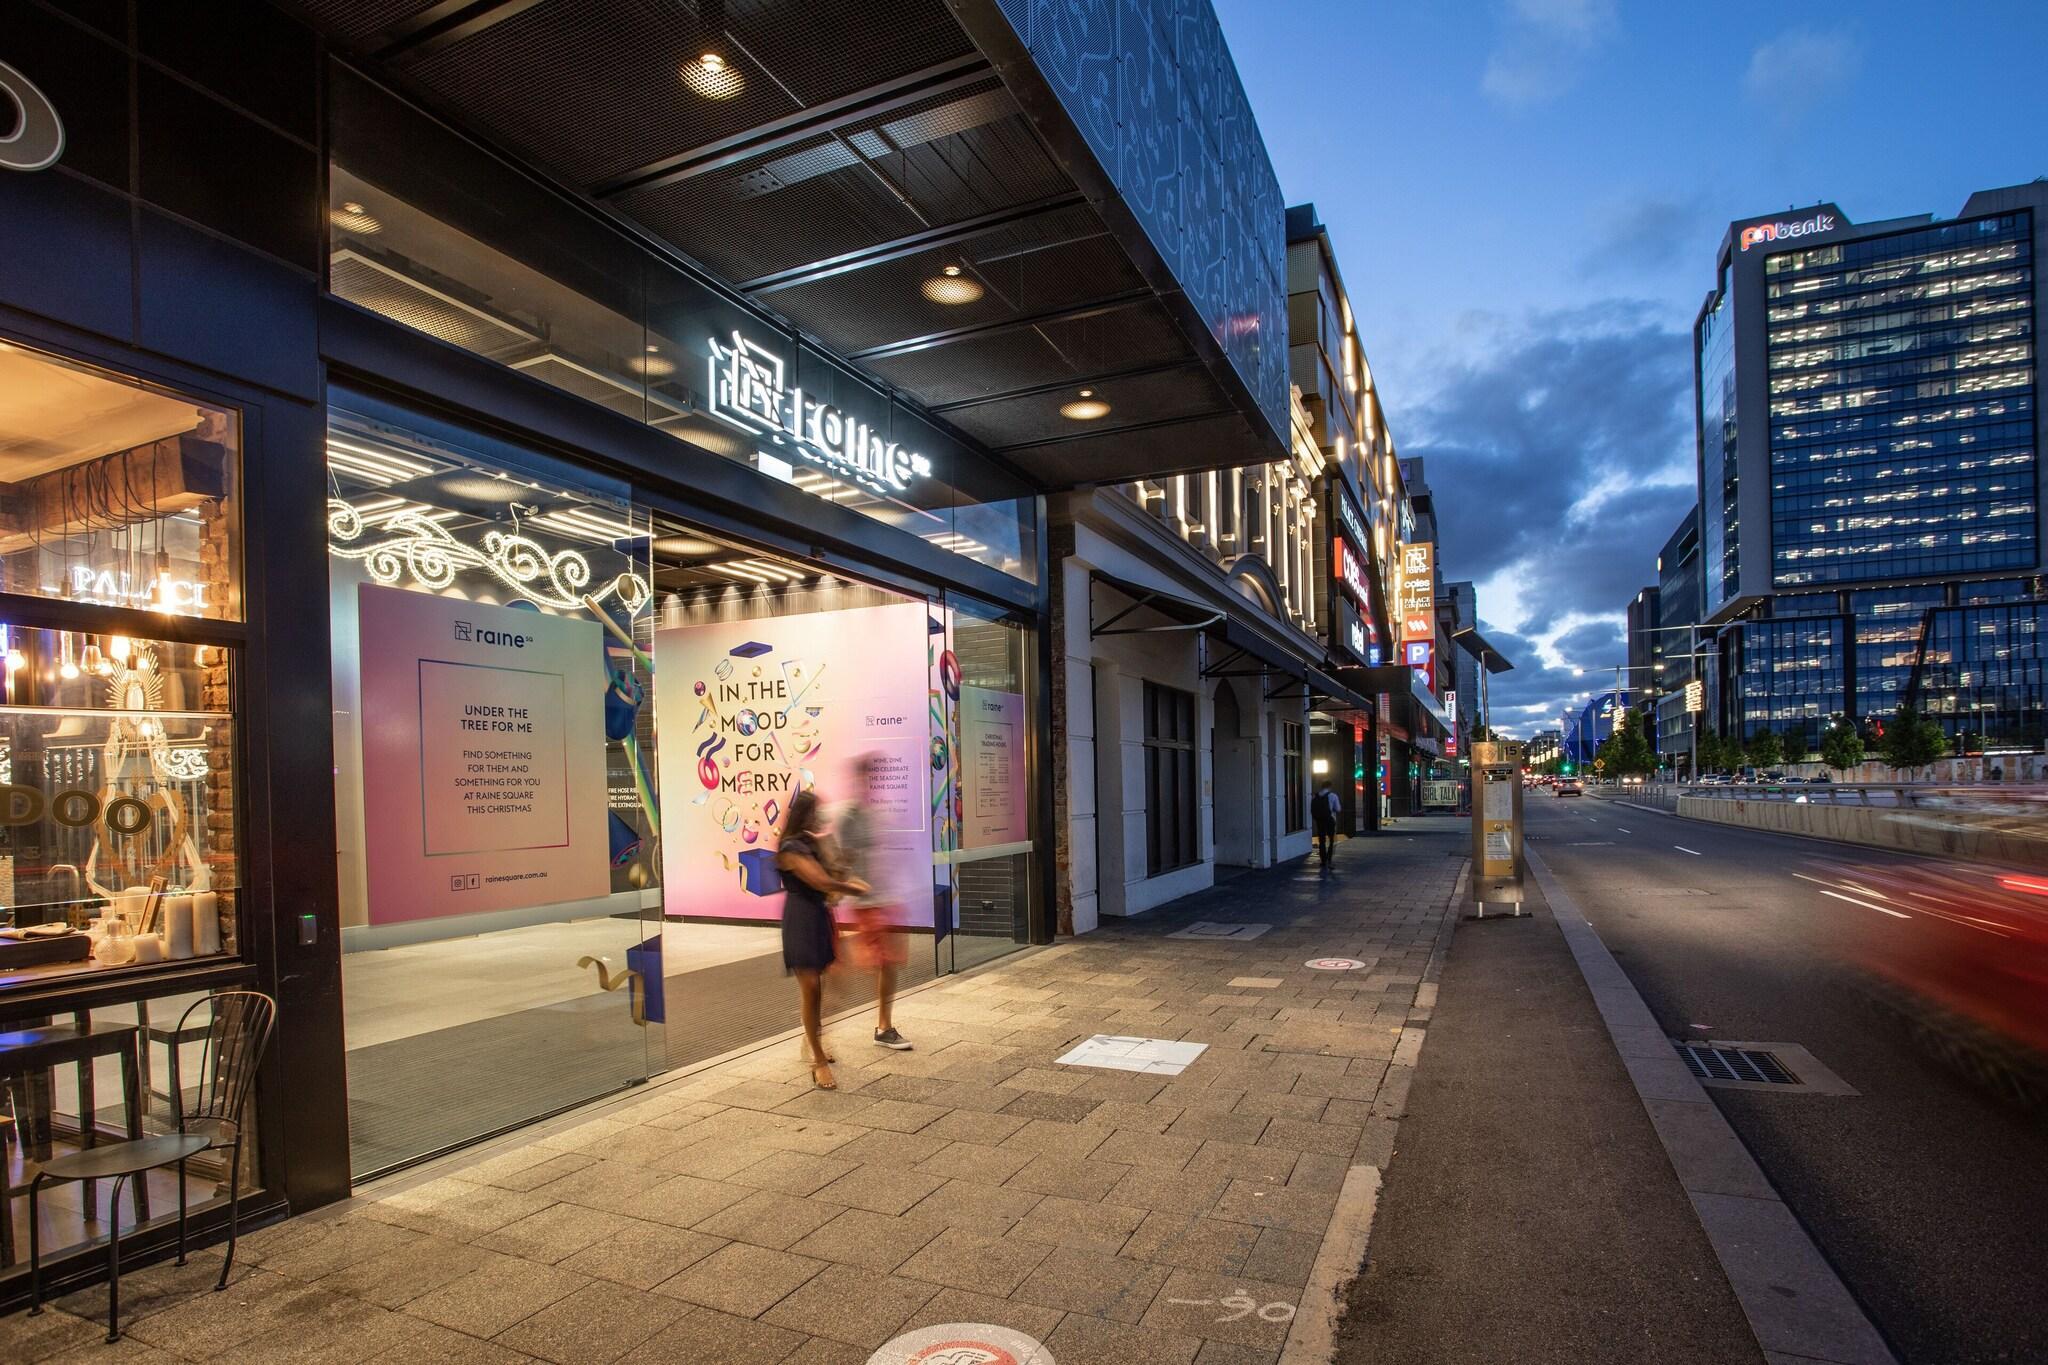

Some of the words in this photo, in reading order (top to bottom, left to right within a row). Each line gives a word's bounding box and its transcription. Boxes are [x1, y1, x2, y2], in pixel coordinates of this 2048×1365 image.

[476, 629, 525, 648] raine
[1412, 646, 1424, 661] P
[720, 683, 740, 702] IN
[748, 680, 787, 700] THE
[465, 704, 504, 717] UNDER
[508, 708, 528, 719] THE
[460, 719, 488, 731] TREE
[492, 721, 514, 732] FOR
[517, 723, 533, 733] ME
[721, 708, 788, 736] MOOD
[876, 716, 903, 726] raine
[463, 750, 483, 759] FIND
[484, 751, 532, 760] SOMETHING
[735, 743, 775, 762] FOR
[1504, 746, 1517, 756] 15
[468, 764, 484, 773] FOR
[486, 764, 509, 773] THEM
[511, 765, 529, 773] AND
[455, 778, 505, 787] SOMETHING
[506, 778, 523, 786] FOR
[524, 778, 541, 786] YOU
[721, 770, 792, 795] MERRY
[464, 792, 474, 801] AT
[476, 791, 501, 800] RAINE
[502, 791, 534, 800] SQUARE
[1423, 786, 1437, 801] GIRL
[1440, 786, 1456, 801] TALK
[467, 805, 486, 814] THIS
[487, 804, 532, 813] CHRISTMAS
[485, 871, 548, 883] rainesquare.com.au
